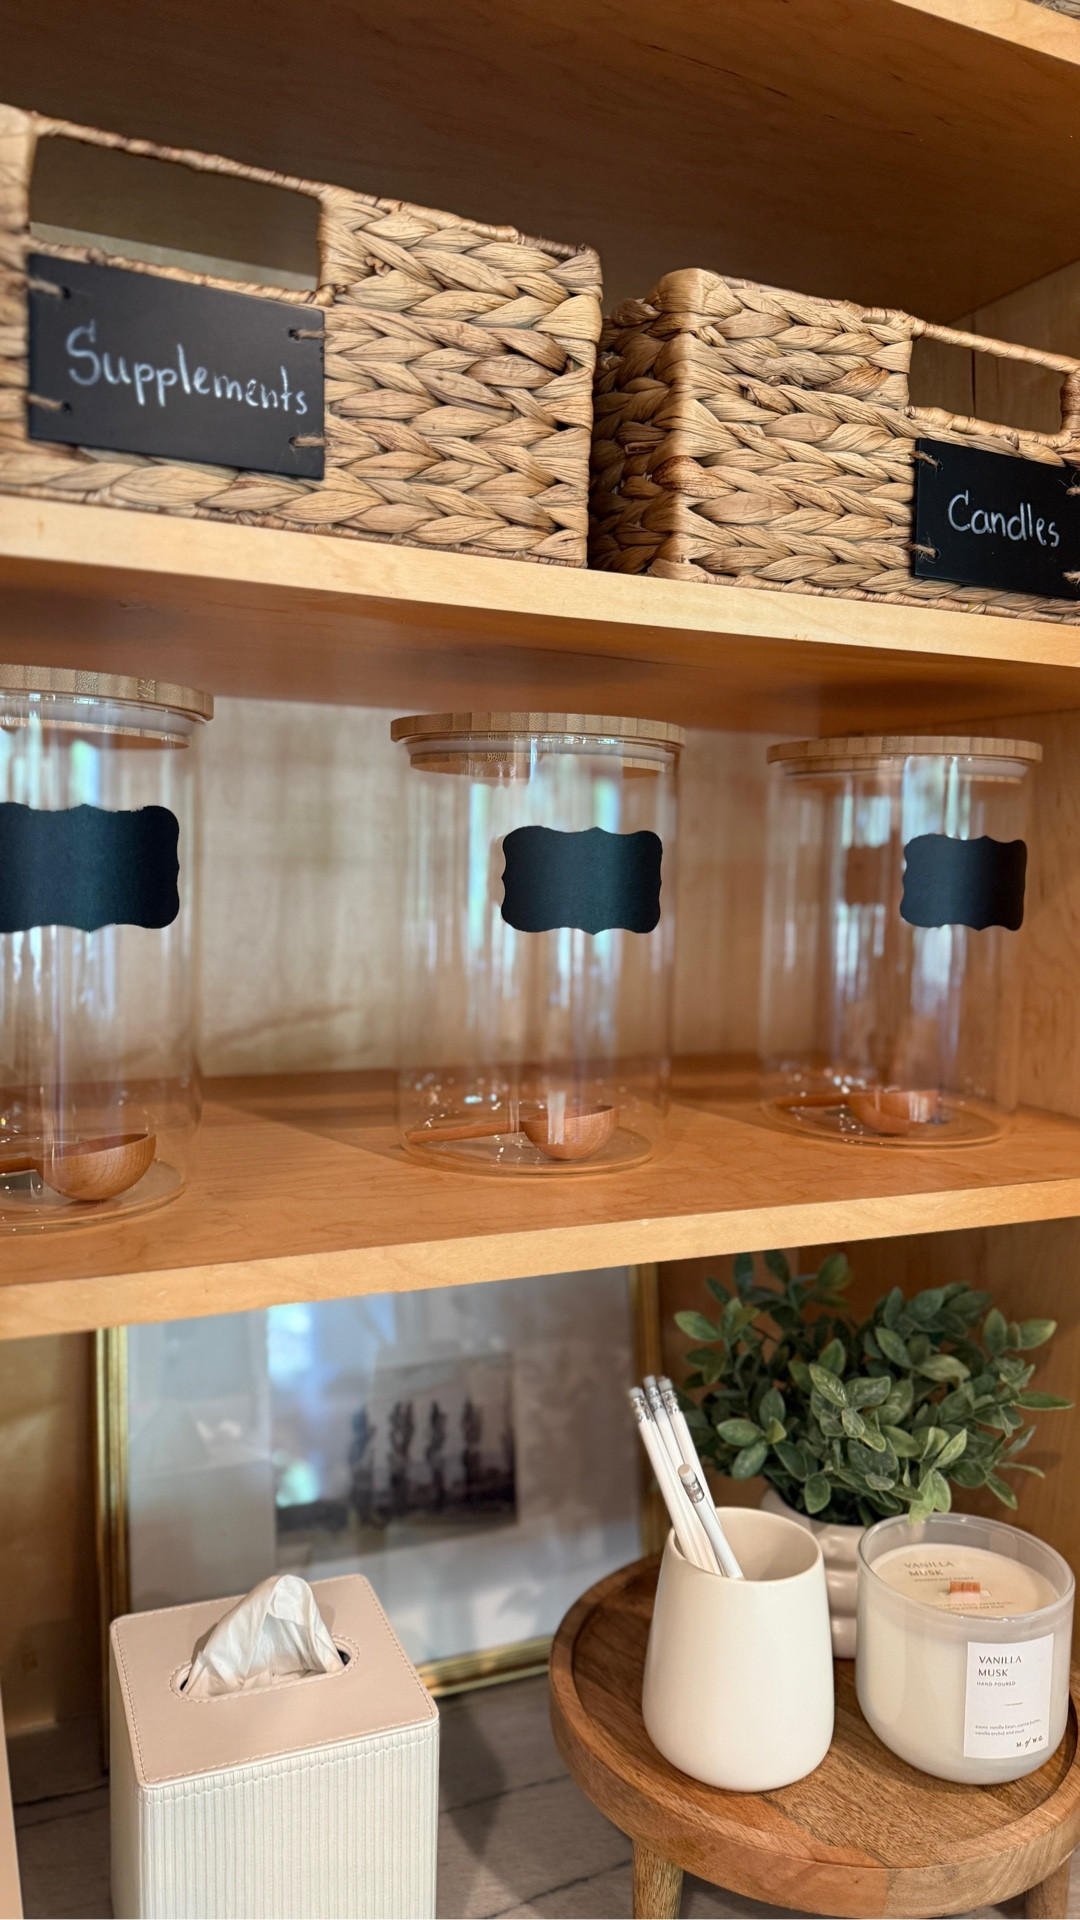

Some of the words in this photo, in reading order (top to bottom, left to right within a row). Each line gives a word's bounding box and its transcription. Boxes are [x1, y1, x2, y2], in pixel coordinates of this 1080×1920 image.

[66, 319, 308, 415] Supplements
[947, 490, 1060, 547] Candles
[978, 1655, 1022, 1664] VANILLA
[978, 1668, 1008, 1677] MUSK
